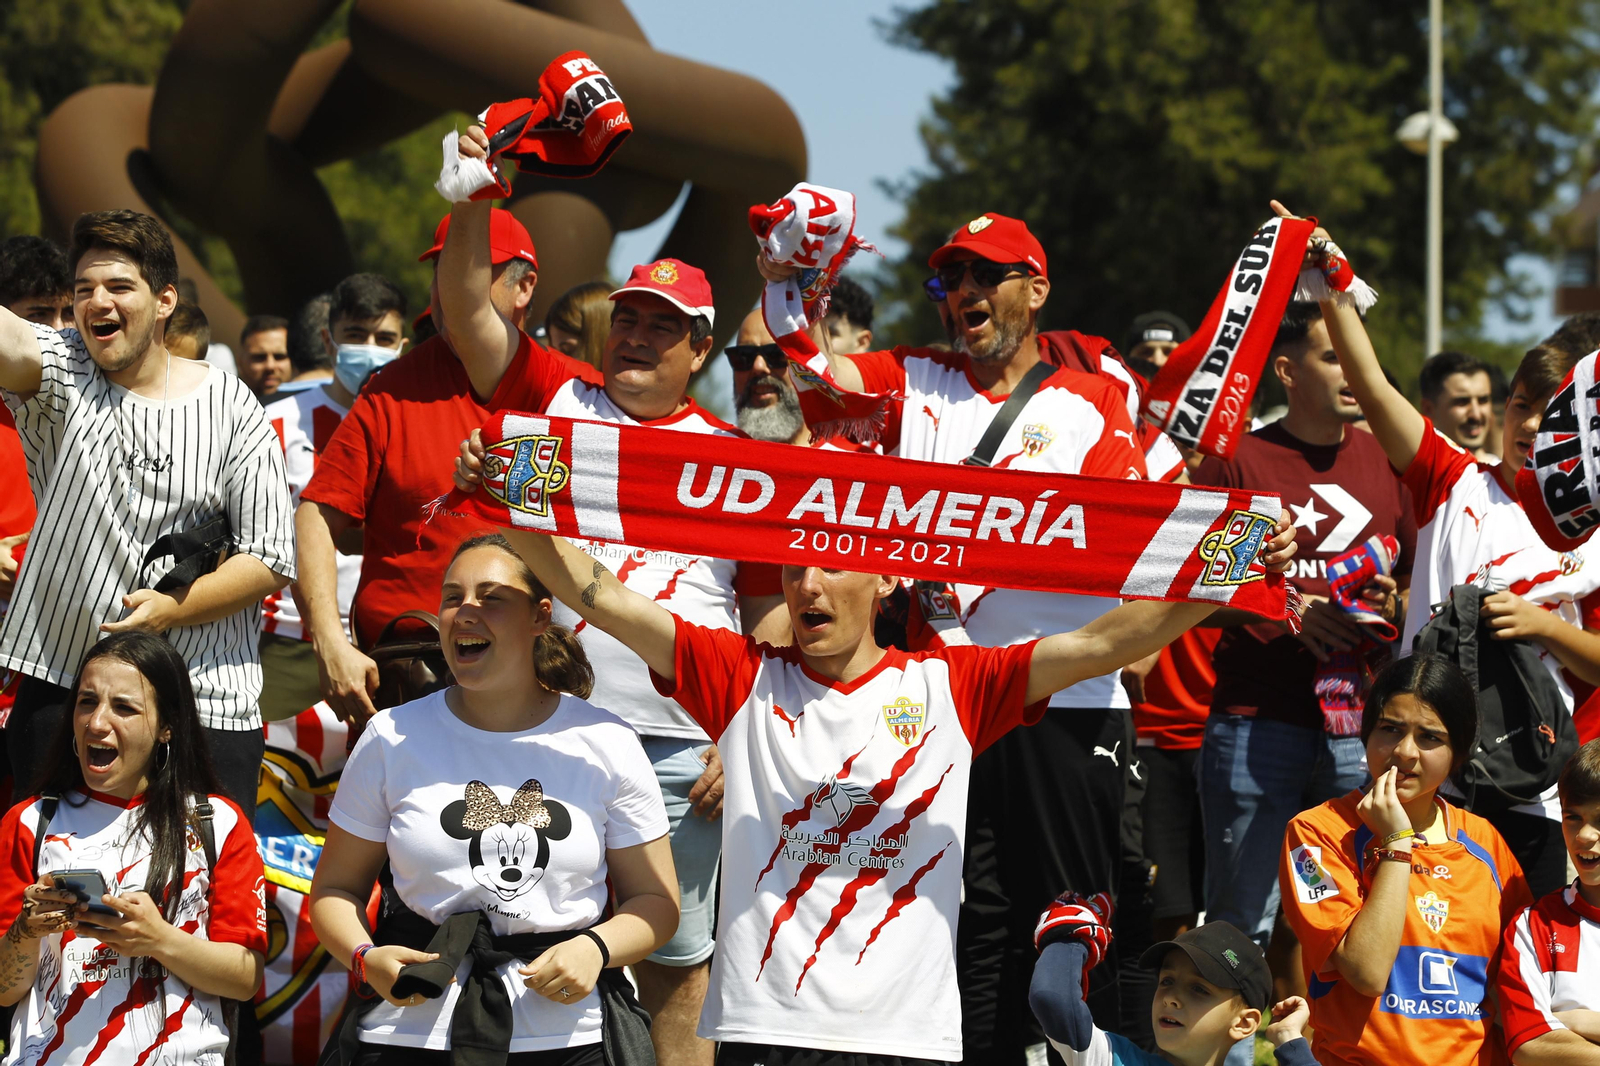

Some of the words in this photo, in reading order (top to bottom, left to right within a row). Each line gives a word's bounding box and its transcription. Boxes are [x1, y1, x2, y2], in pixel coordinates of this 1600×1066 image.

[1202, 305, 1253, 378] DEL
[1234, 224, 1278, 296] SUR
[676, 462, 776, 514] UD
[786, 477, 1088, 550] ALMERÍA
[574, 541, 627, 560] rabian
[632, 548, 689, 571] Centres
[788, 527, 966, 568] 2001-2021
[781, 845, 841, 865] Arabian
[847, 851, 905, 869] Centres
[1308, 884, 1328, 900] LFP
[68, 964, 132, 983] Arabian
